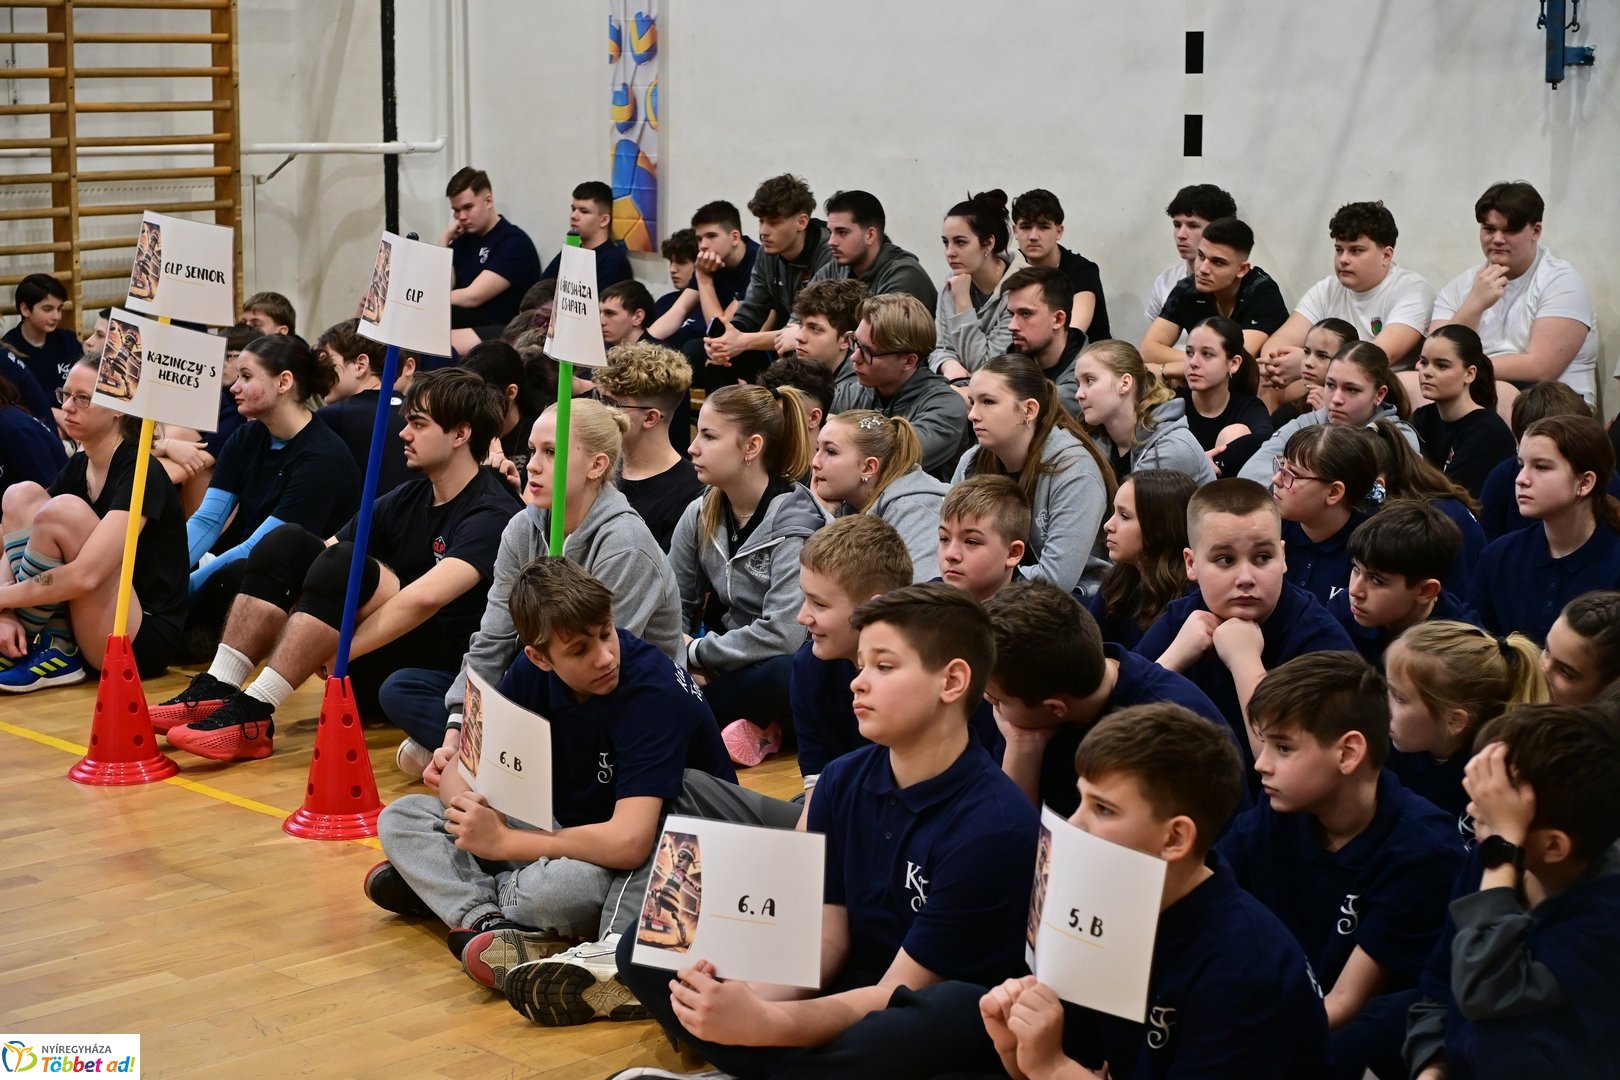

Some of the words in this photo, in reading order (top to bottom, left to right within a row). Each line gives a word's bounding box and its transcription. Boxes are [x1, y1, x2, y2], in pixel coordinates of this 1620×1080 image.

[164, 261, 183, 275] GLP
[185, 265, 226, 285] SENIOR
[405, 287, 424, 303] GLP
[158, 368, 200, 389] HEROES
[500, 751, 510, 768] 6.
[513, 756, 523, 772] B
[738, 894, 755, 915] 6.
[761, 897, 776, 917] A
[1068, 907, 1083, 932] 5.
[1090, 915, 1104, 938] B
